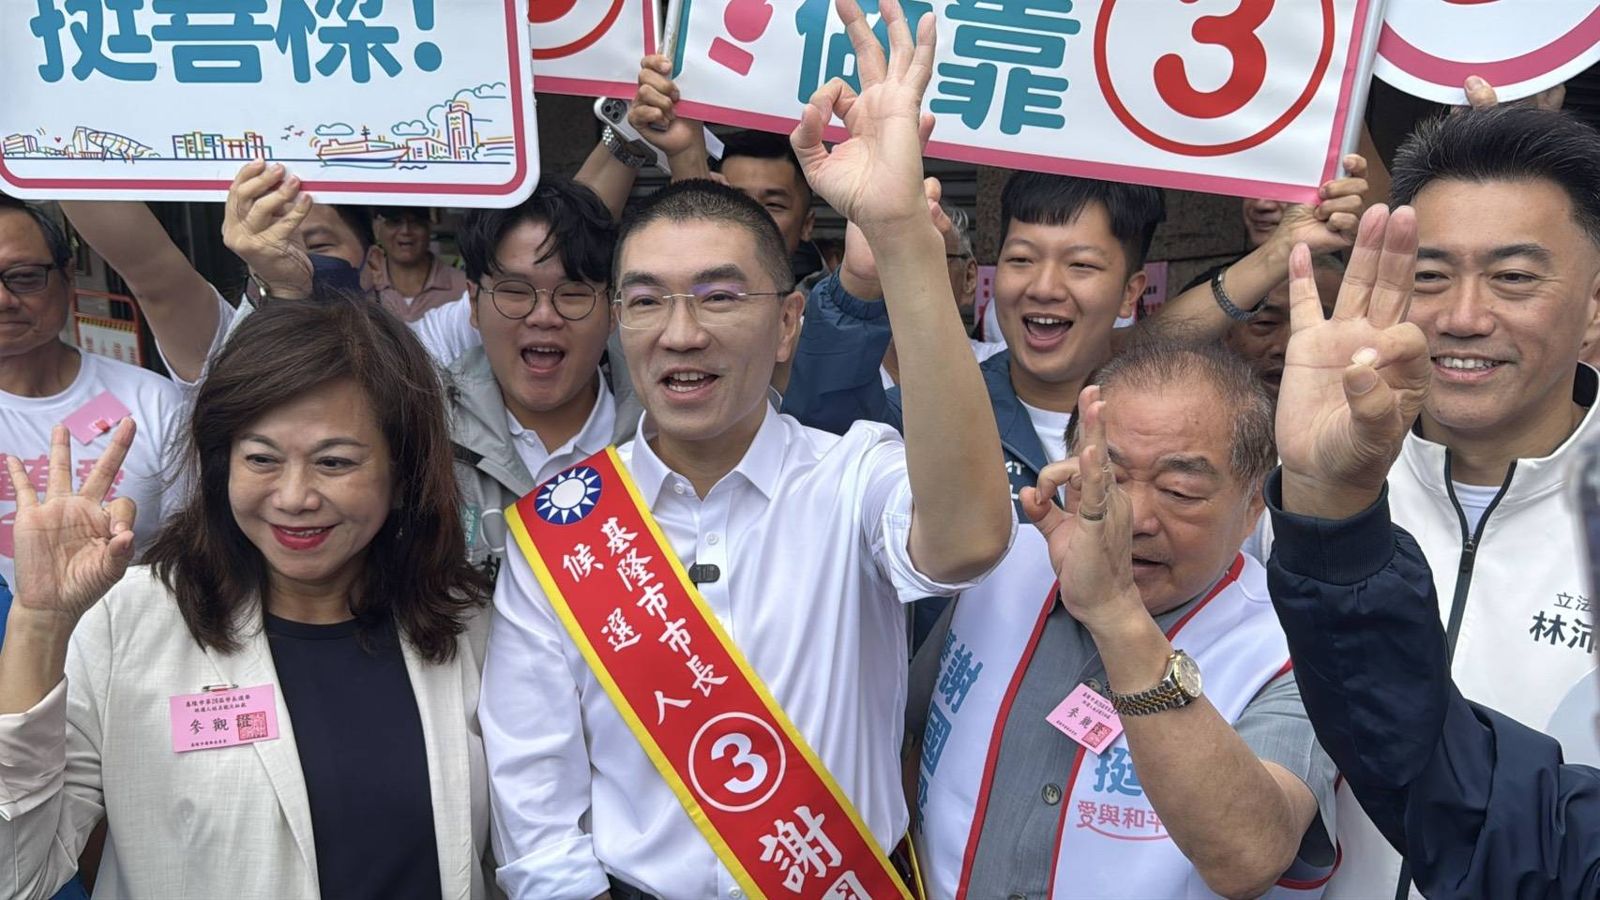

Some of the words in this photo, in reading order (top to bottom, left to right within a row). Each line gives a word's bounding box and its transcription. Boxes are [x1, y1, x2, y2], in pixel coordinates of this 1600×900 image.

[562, 543, 692, 726] 候選人
[600, 517, 729, 697] 基隆市市長
[711, 732, 768, 794] 3
[1093, 747, 1142, 796] 挺
